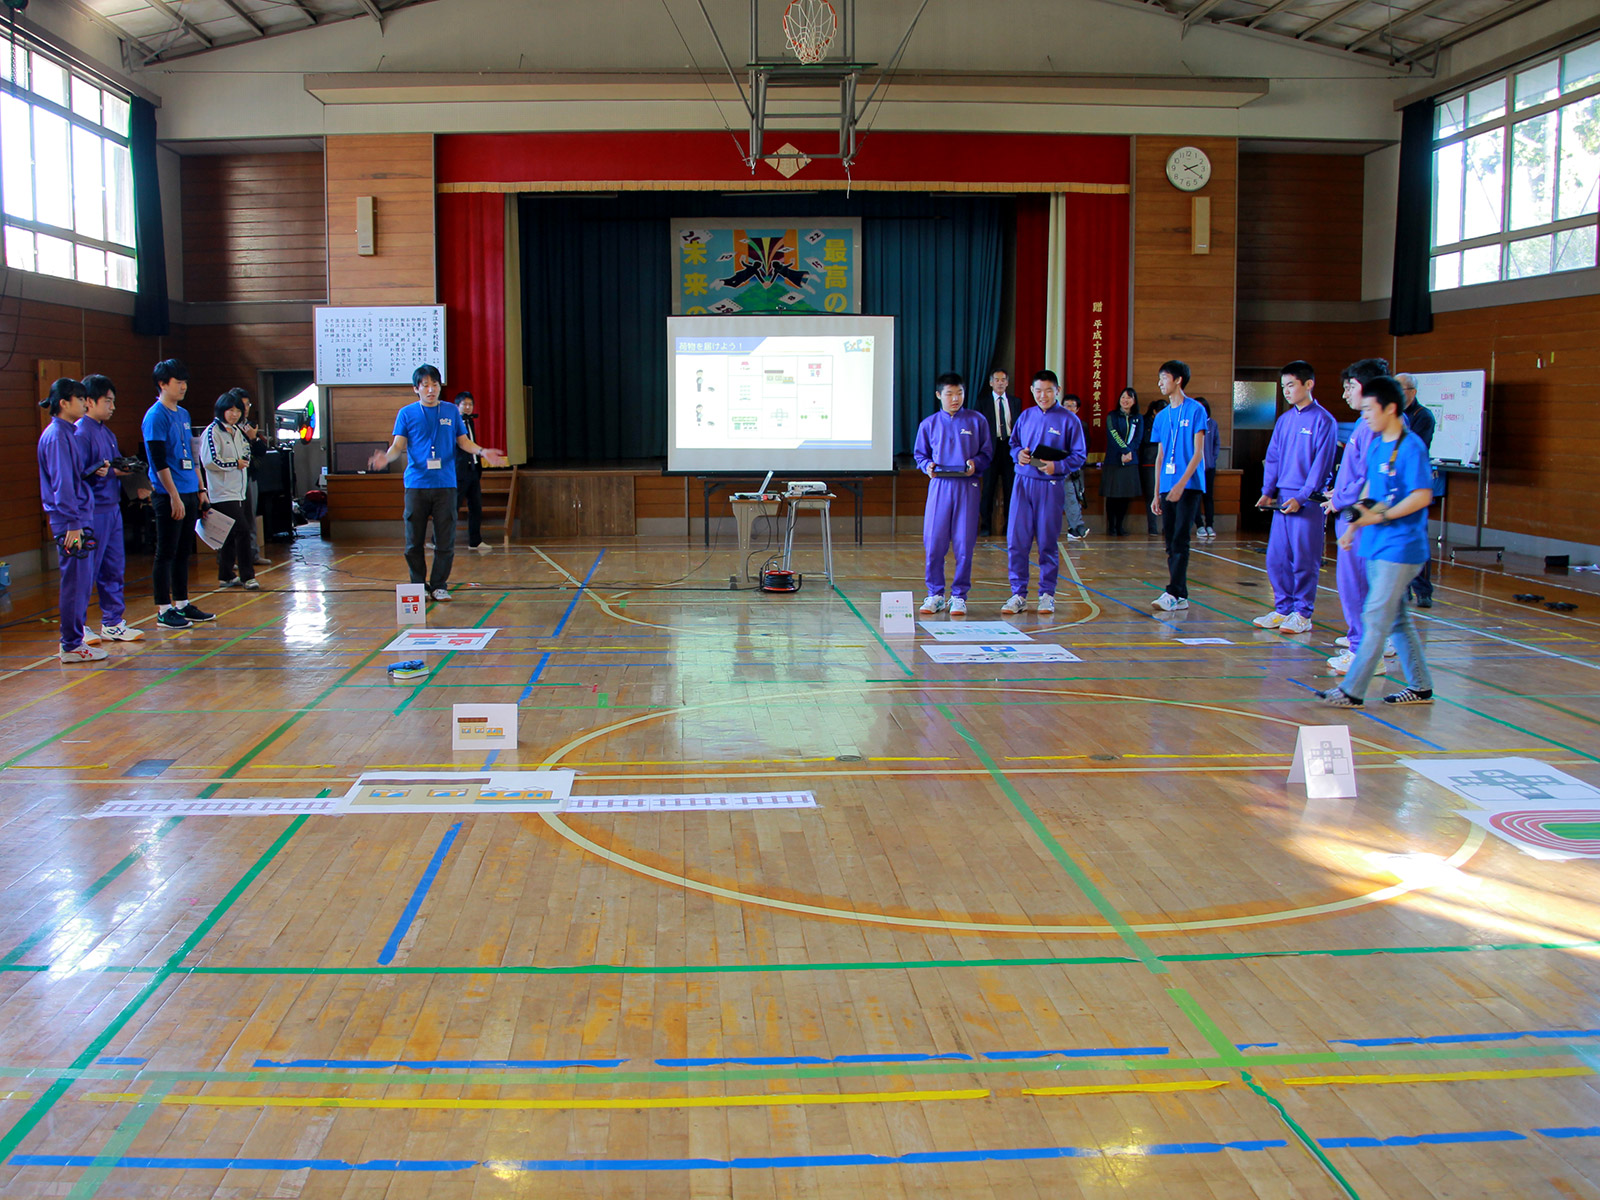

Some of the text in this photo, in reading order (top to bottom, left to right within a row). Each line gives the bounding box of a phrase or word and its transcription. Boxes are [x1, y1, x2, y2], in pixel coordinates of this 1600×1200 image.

[810, 232, 821, 242] 22
[824, 239, 848, 312] 最高の
[1092, 301, 1103, 428] 贈 平成十五年度卒業生一同
